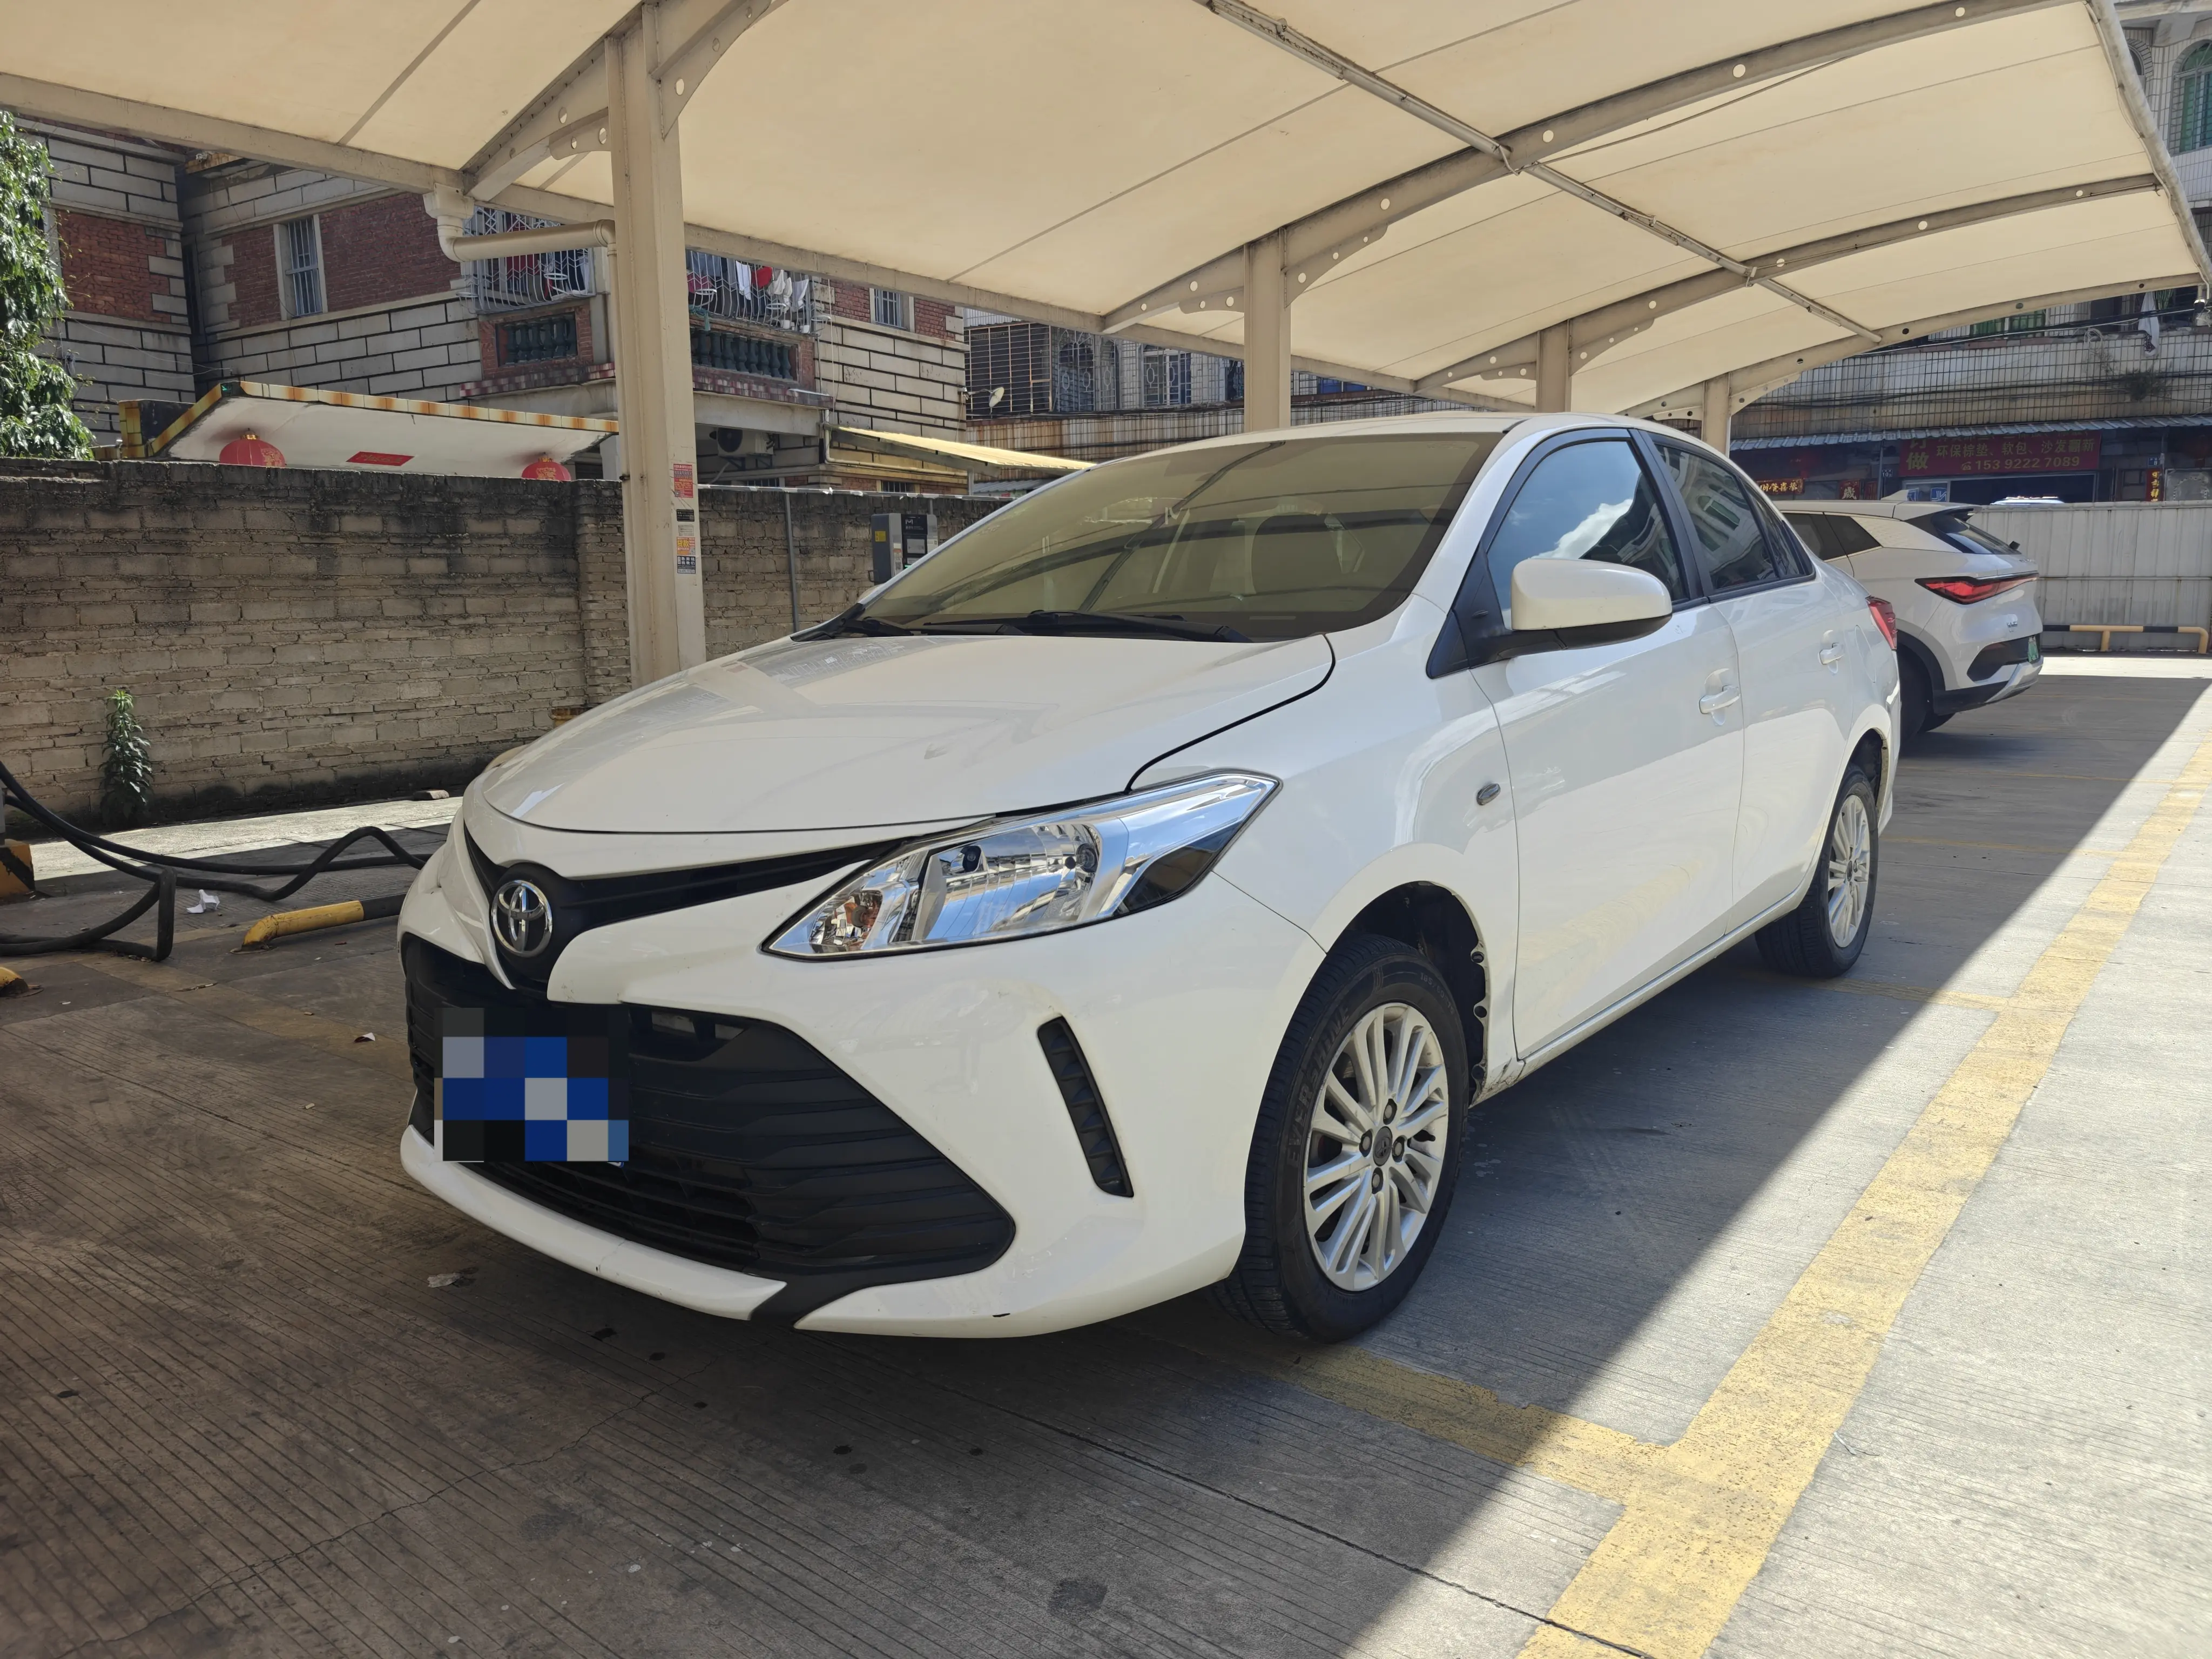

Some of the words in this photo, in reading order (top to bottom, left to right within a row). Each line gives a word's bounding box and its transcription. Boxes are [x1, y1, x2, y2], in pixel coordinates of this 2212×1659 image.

[1975, 460, 2001, 470] 153
[2005, 457, 2040, 469] 9222
[2044, 456, 2080, 468] 7089
